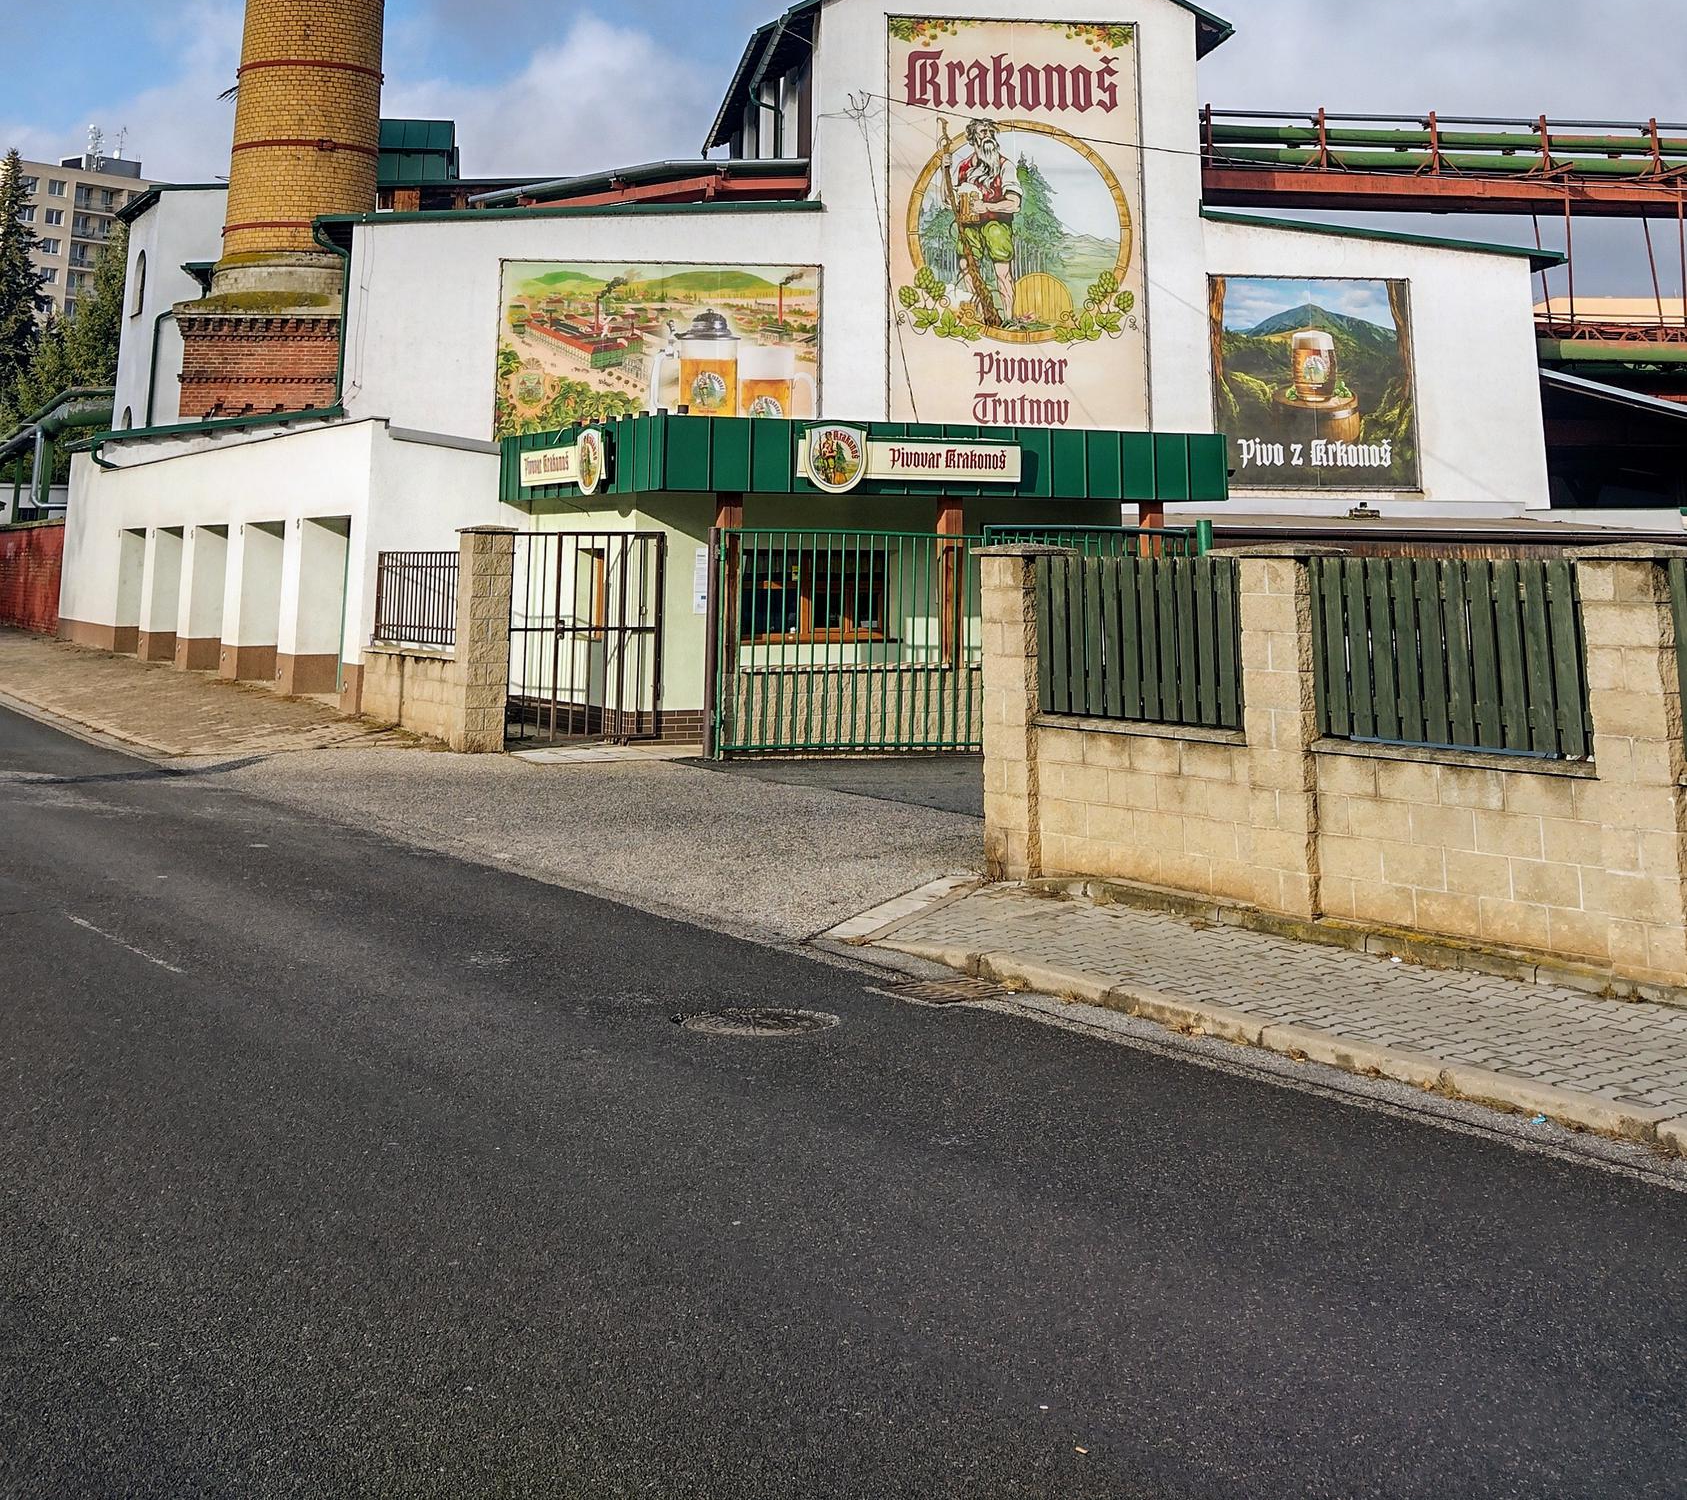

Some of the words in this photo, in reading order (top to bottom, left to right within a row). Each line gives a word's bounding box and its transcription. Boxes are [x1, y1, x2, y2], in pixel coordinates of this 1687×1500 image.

[904, 49, 1120, 113] Krakonoš
[973, 350, 1068, 386] Pivovar
[972, 393, 1070, 425] Trutnov
[832, 430, 861, 459] Krakonoš
[889, 447, 942, 469] Pivovar
[945, 448, 1007, 470] Krakonoš
[1236, 437, 1285, 468] Pivo
[1290, 443, 1304, 466] z
[1310, 439, 1393, 467] Krkonoš
